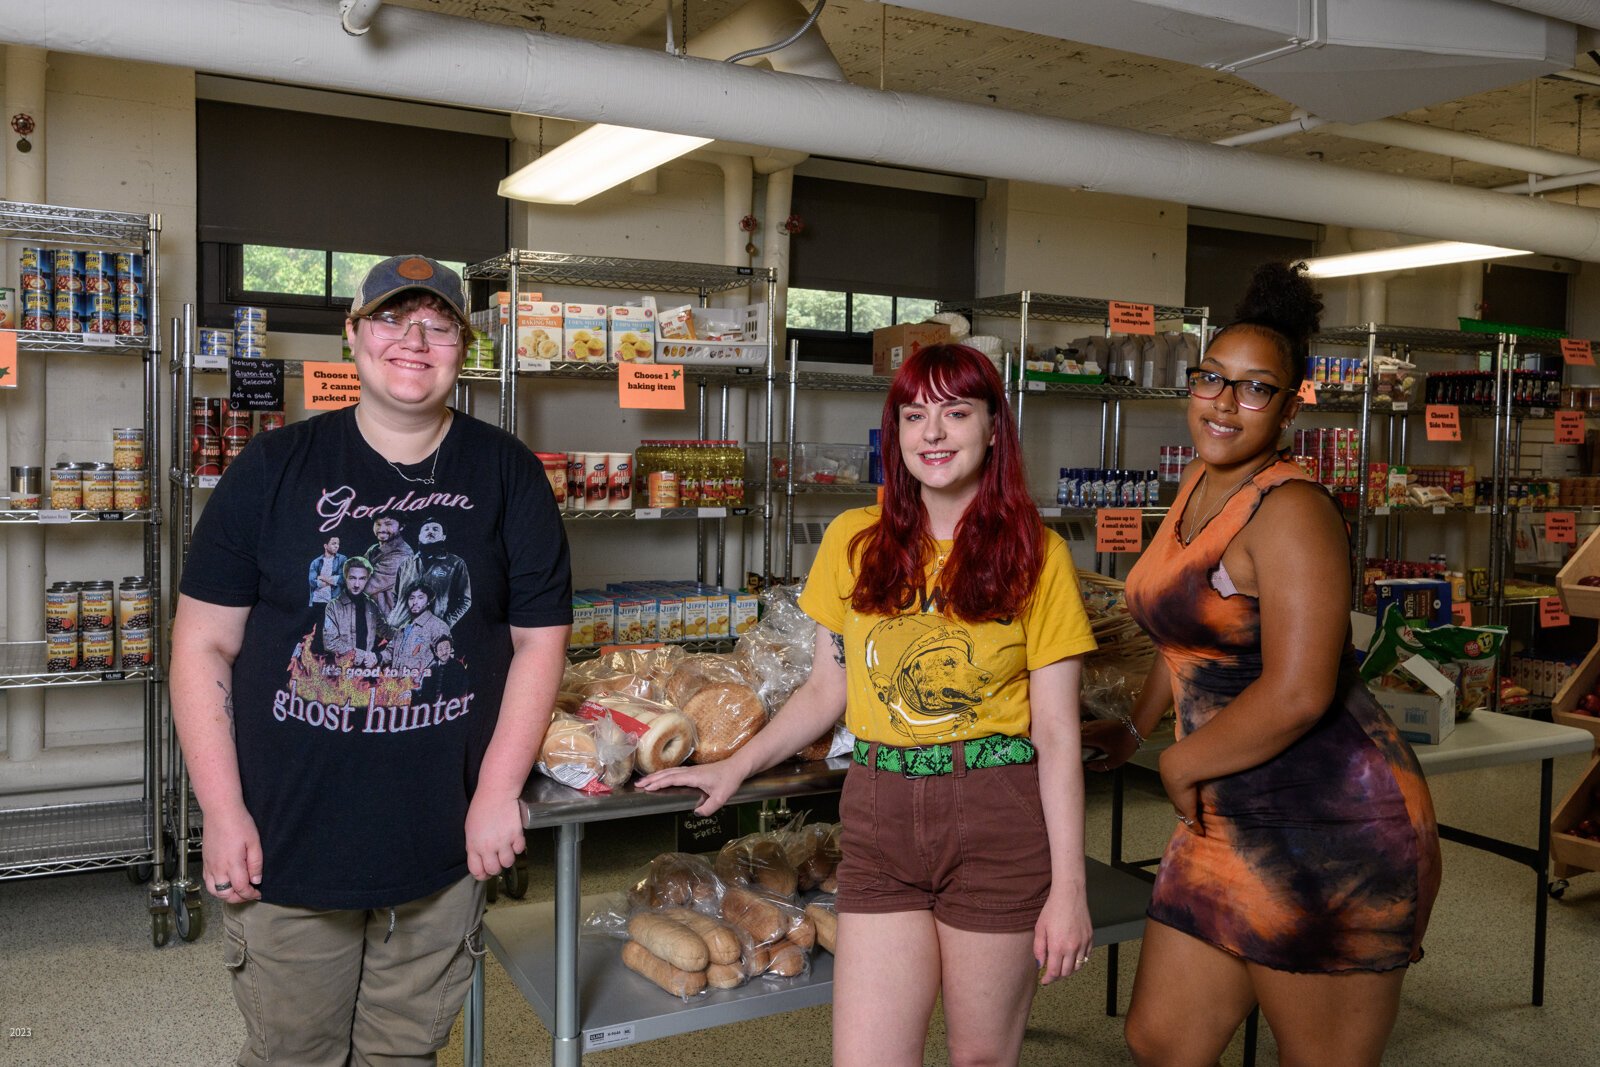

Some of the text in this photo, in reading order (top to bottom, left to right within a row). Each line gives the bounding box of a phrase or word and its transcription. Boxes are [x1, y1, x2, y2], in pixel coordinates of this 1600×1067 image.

[313, 370, 348, 379] Choose
[634, 372, 662, 380] Choose
[628, 382, 676, 392] baking item
[312, 394, 348, 403] packed
[316, 486, 474, 533] Goddamn
[322, 665, 432, 680] it's good to be a
[272, 680, 476, 733] ghost hunter
